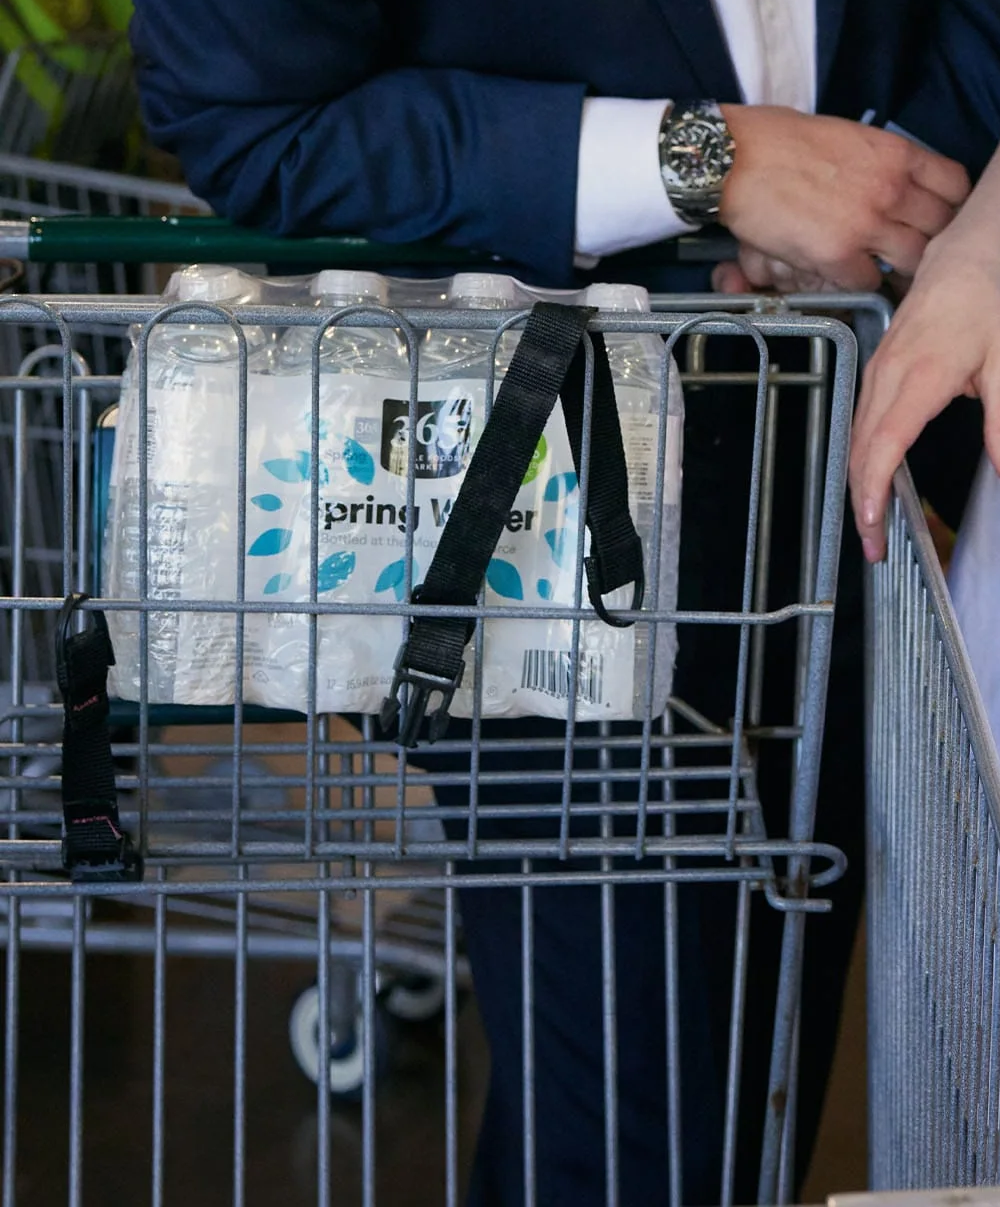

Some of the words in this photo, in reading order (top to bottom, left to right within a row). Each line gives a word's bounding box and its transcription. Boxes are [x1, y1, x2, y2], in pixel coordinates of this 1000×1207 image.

[314, 494, 420, 534] pring
[430, 497, 538, 533] Wer
[320, 532, 367, 546] Bottled
[370, 534, 384, 547] at
